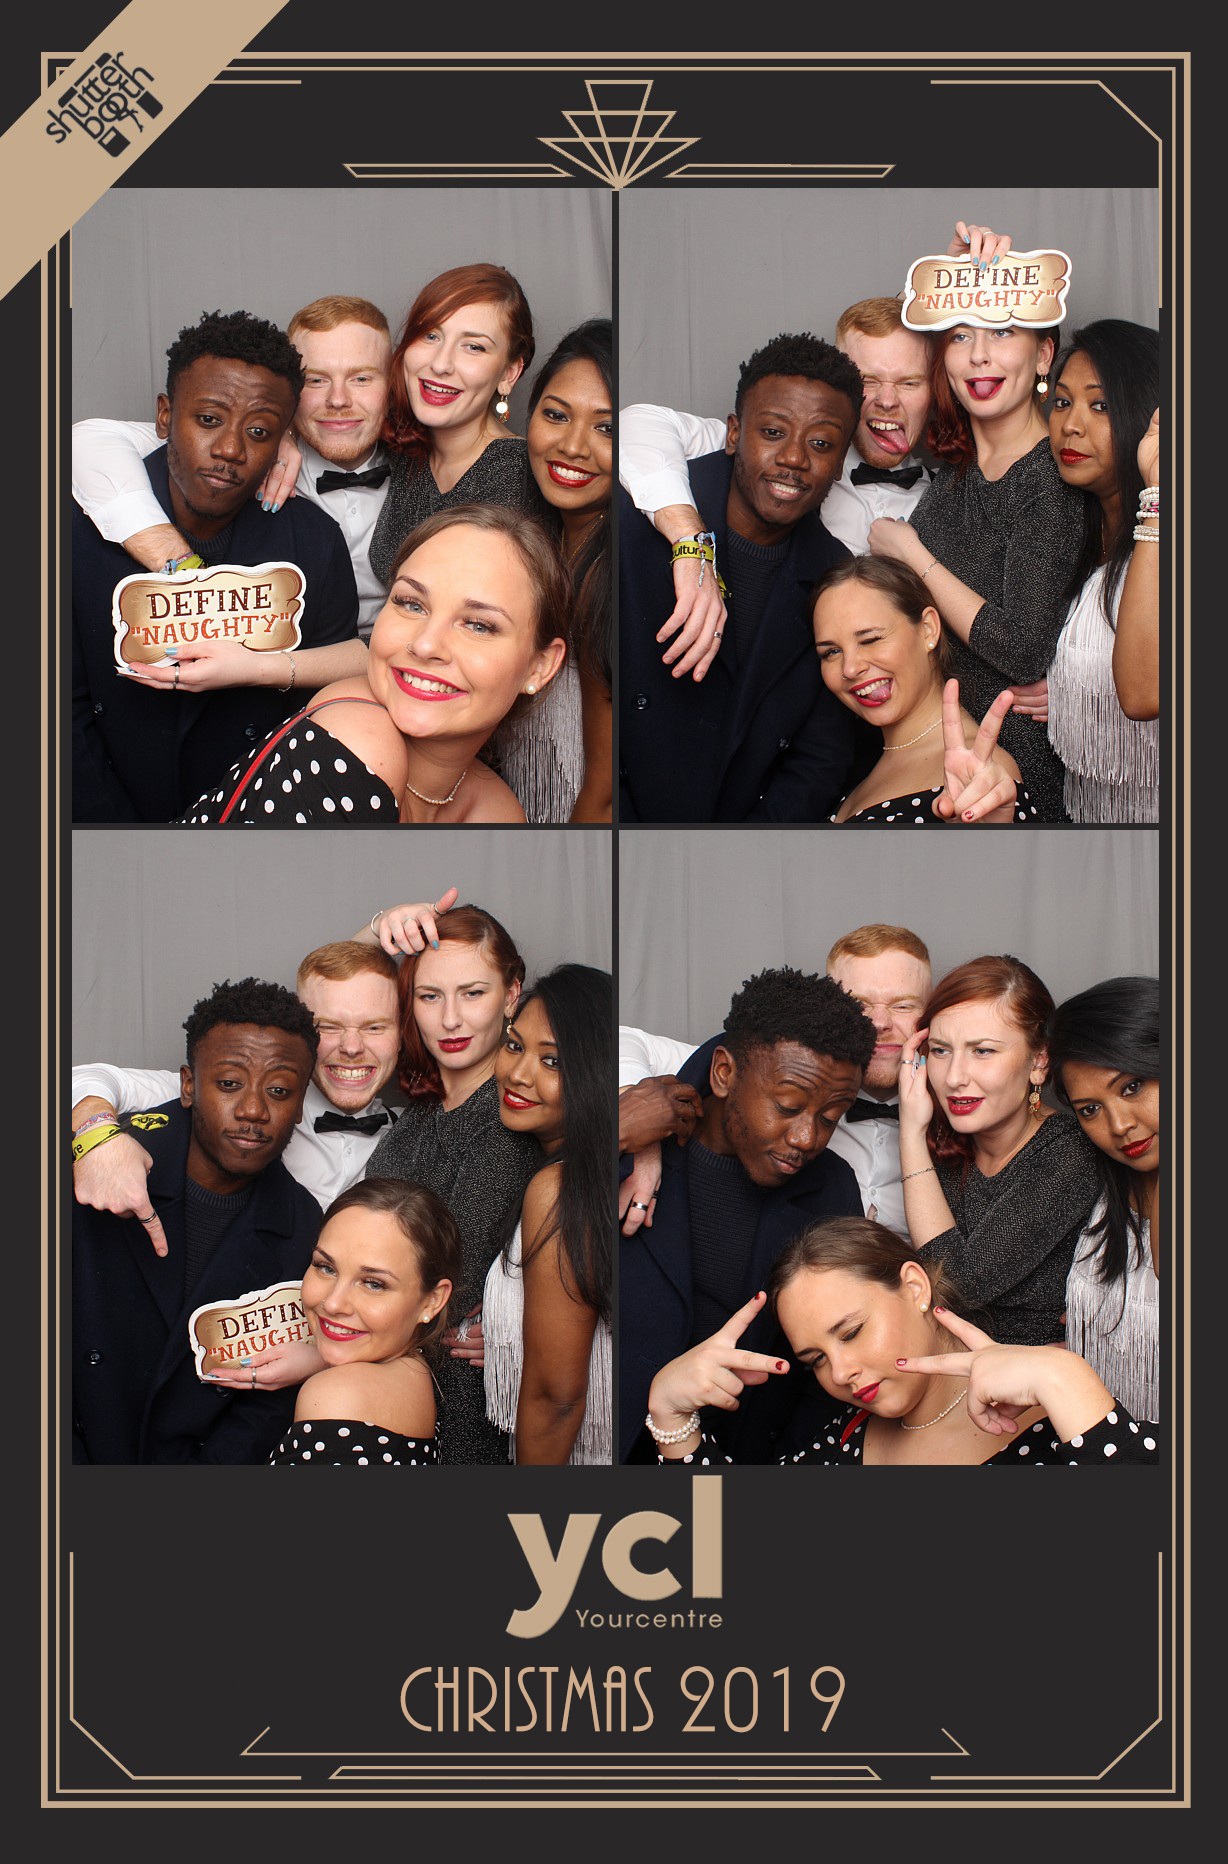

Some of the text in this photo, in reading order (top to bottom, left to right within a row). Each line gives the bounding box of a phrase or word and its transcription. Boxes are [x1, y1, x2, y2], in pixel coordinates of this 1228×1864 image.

[933, 264, 1041, 289] DEFINE
[917, 288, 1056, 310] "NAUGHTY"
[673, 544, 708, 558] ultur
[146, 583, 273, 619] DEFINE
[130, 611, 290, 646] "NAUGHTY"
[216, 1298, 306, 1340] DEFIN
[207, 1321, 314, 1362] "NAUGHT
